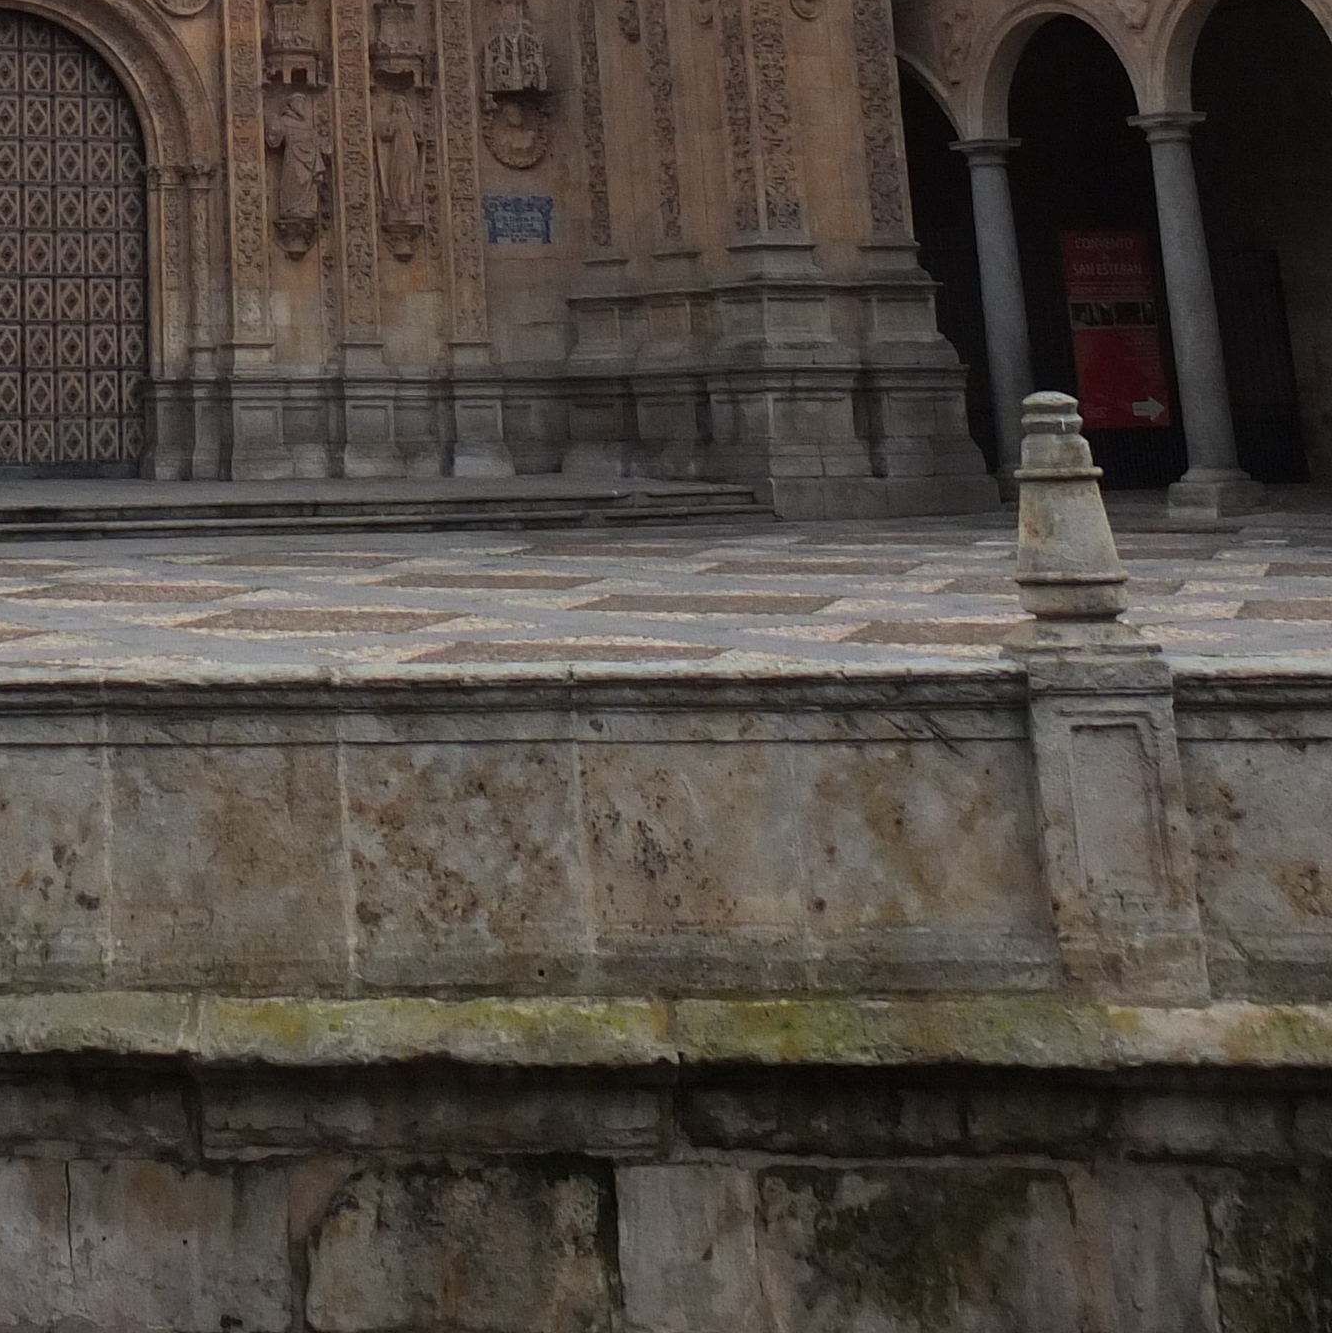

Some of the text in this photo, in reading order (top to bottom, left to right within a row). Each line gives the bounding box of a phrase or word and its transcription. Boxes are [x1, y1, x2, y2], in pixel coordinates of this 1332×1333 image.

[1074, 237, 1134, 250] CONVENTO
[1072, 263, 1142, 276] SAN ESTEBAN
